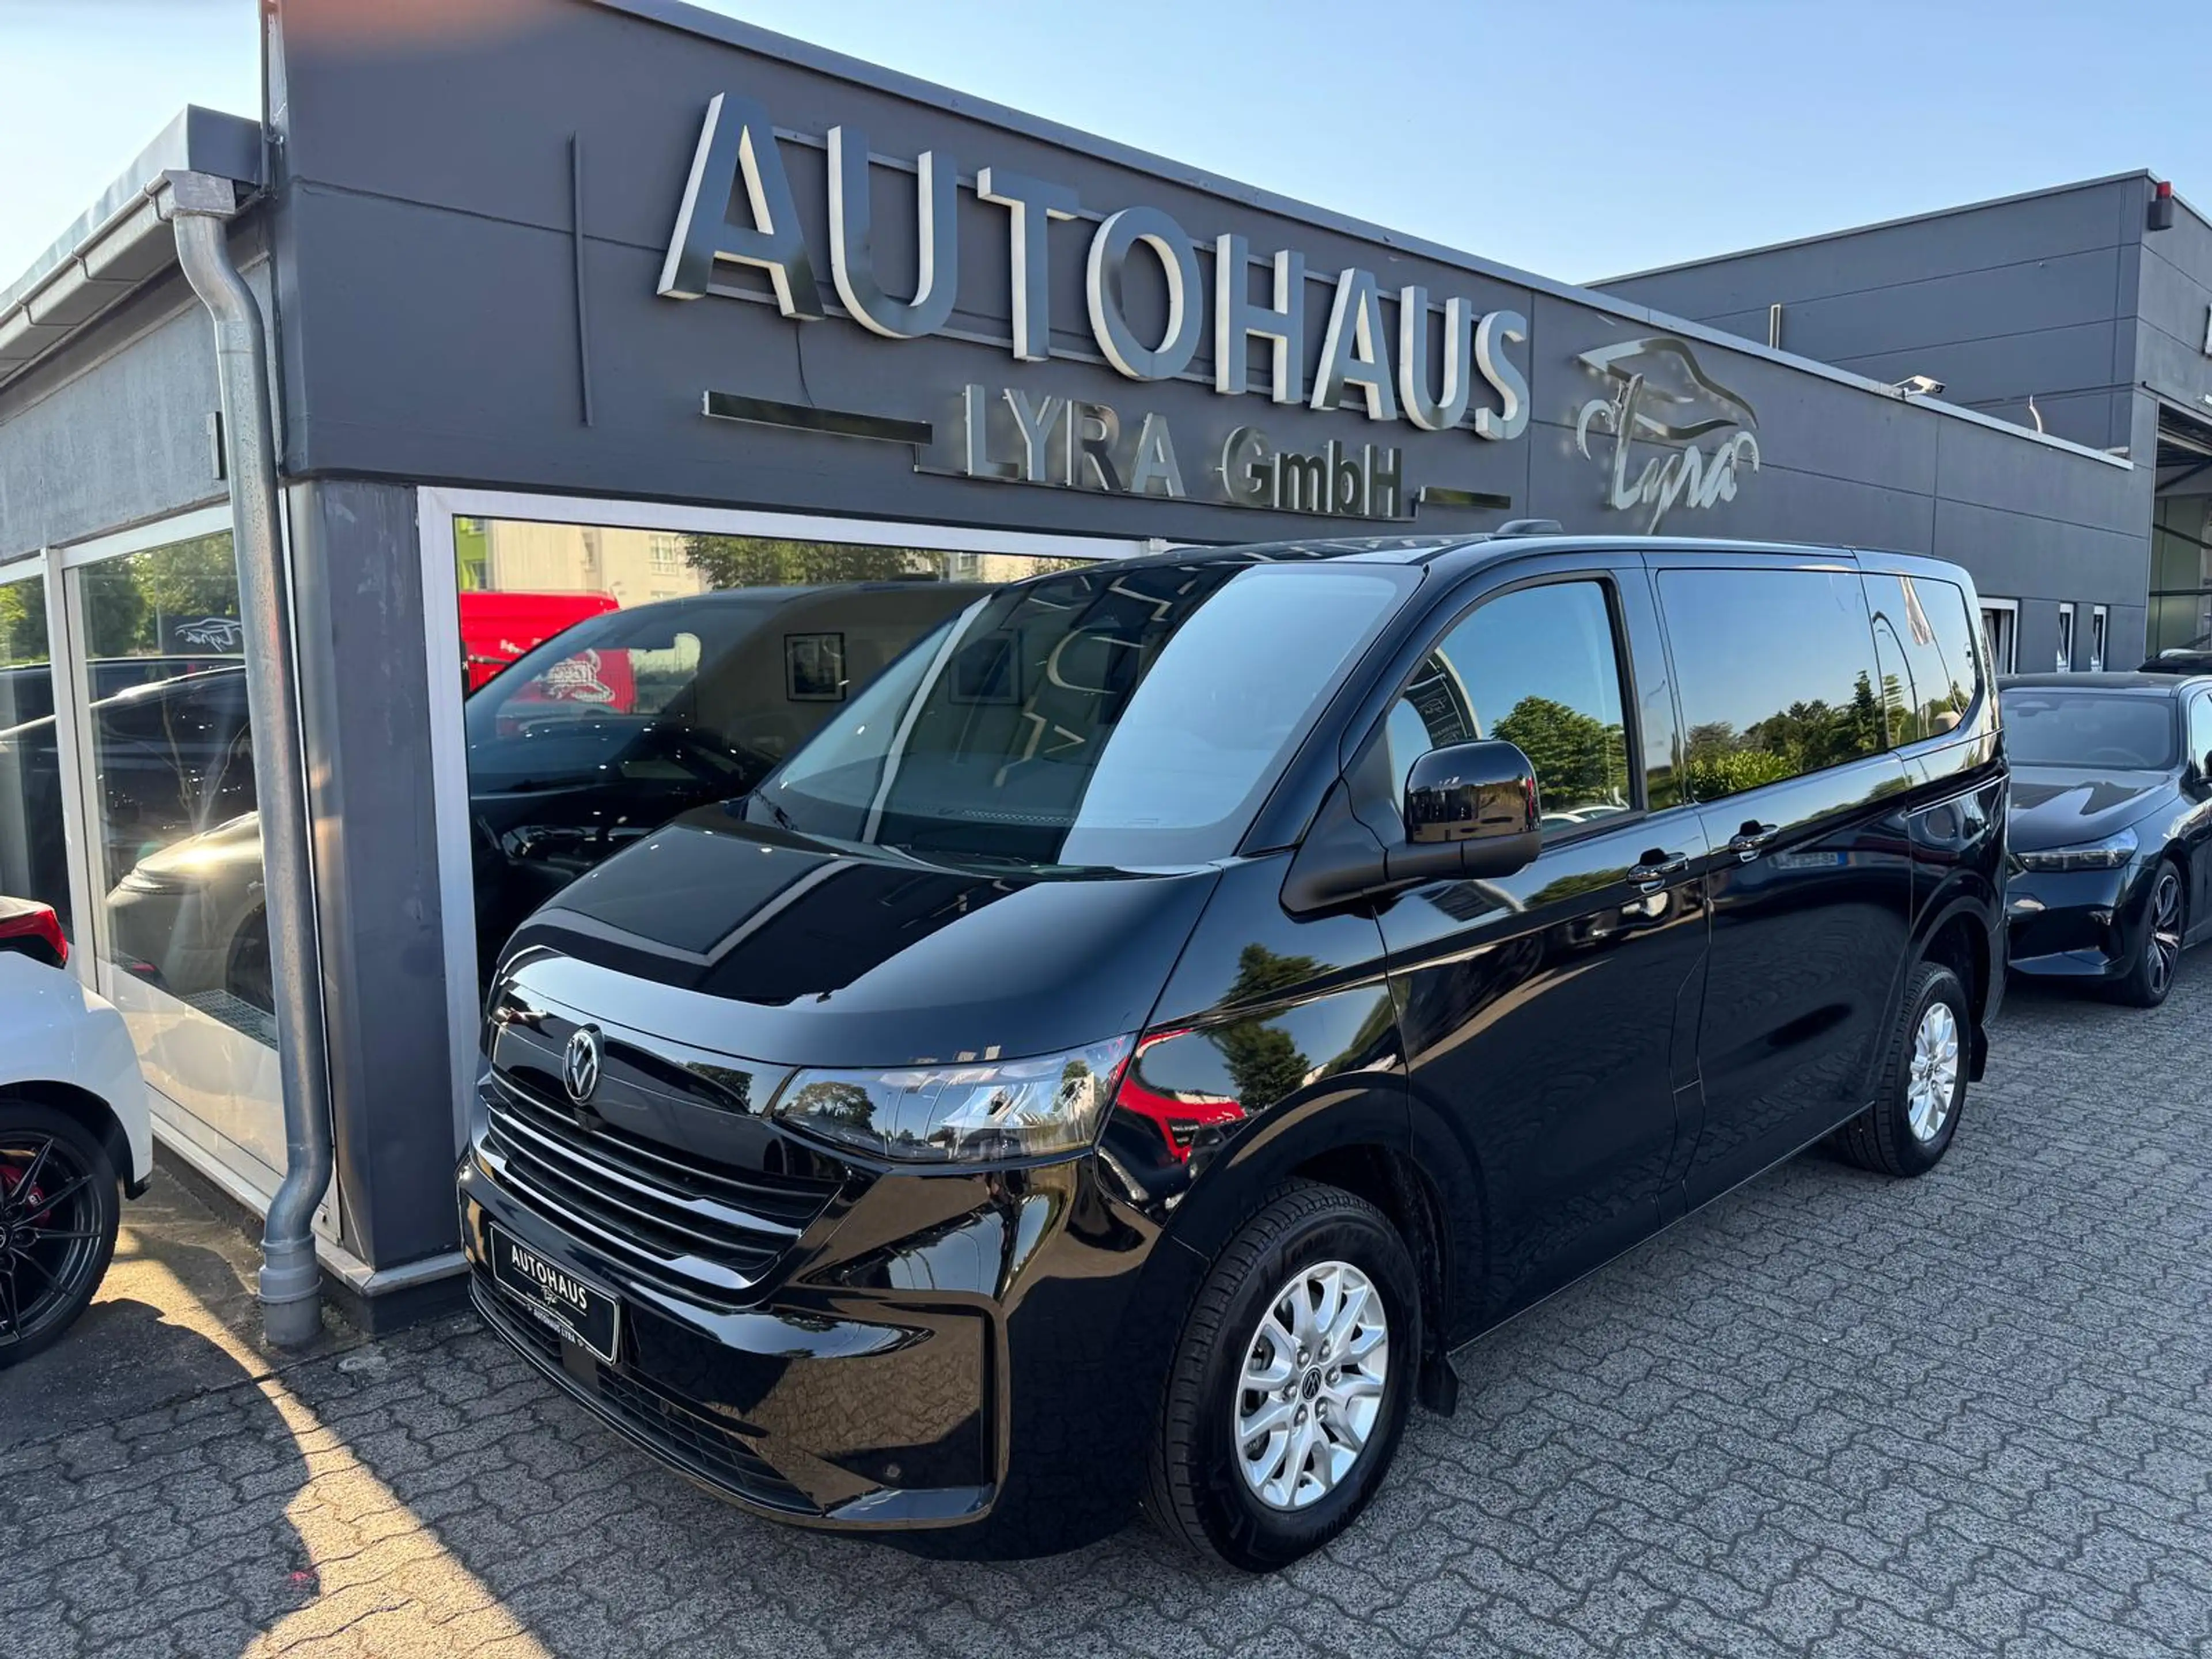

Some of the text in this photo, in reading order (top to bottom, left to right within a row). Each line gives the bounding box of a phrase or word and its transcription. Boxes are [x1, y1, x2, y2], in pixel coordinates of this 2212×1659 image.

[657, 91, 1530, 441] AUTOHAUS
[964, 383, 1402, 518] LYRA GmbH
[512, 1244, 588, 1309] AUTOHAUS
